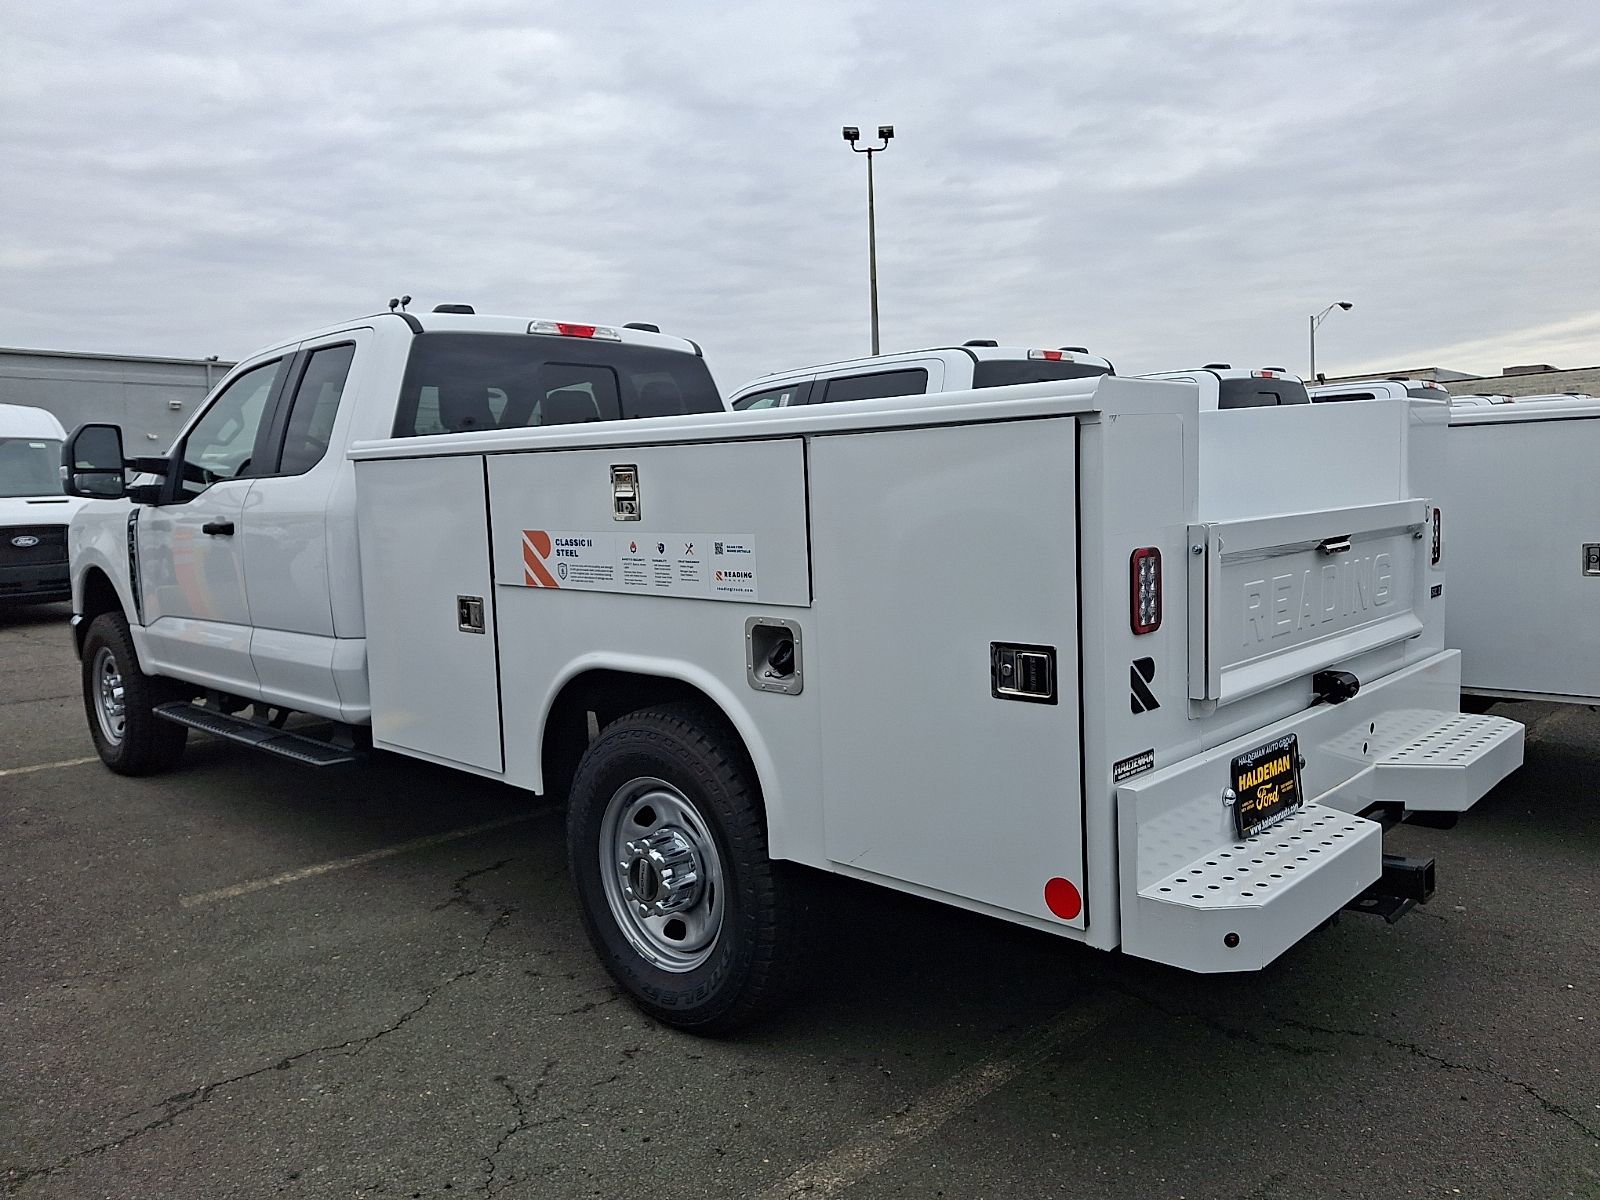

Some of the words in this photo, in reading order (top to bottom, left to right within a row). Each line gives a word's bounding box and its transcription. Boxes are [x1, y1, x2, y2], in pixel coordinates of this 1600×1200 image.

[555, 538, 586, 547] CLASSIC
[556, 548, 579, 557] STEEL
[724, 571, 753, 579] READING
[1242, 552, 1393, 648] READING
[1265, 742, 1279, 754] AUTO
[1278, 734, 1296, 749] GROUP
[1238, 754, 1291, 792] HALDEMAN
[1256, 782, 1280, 811] Ford
